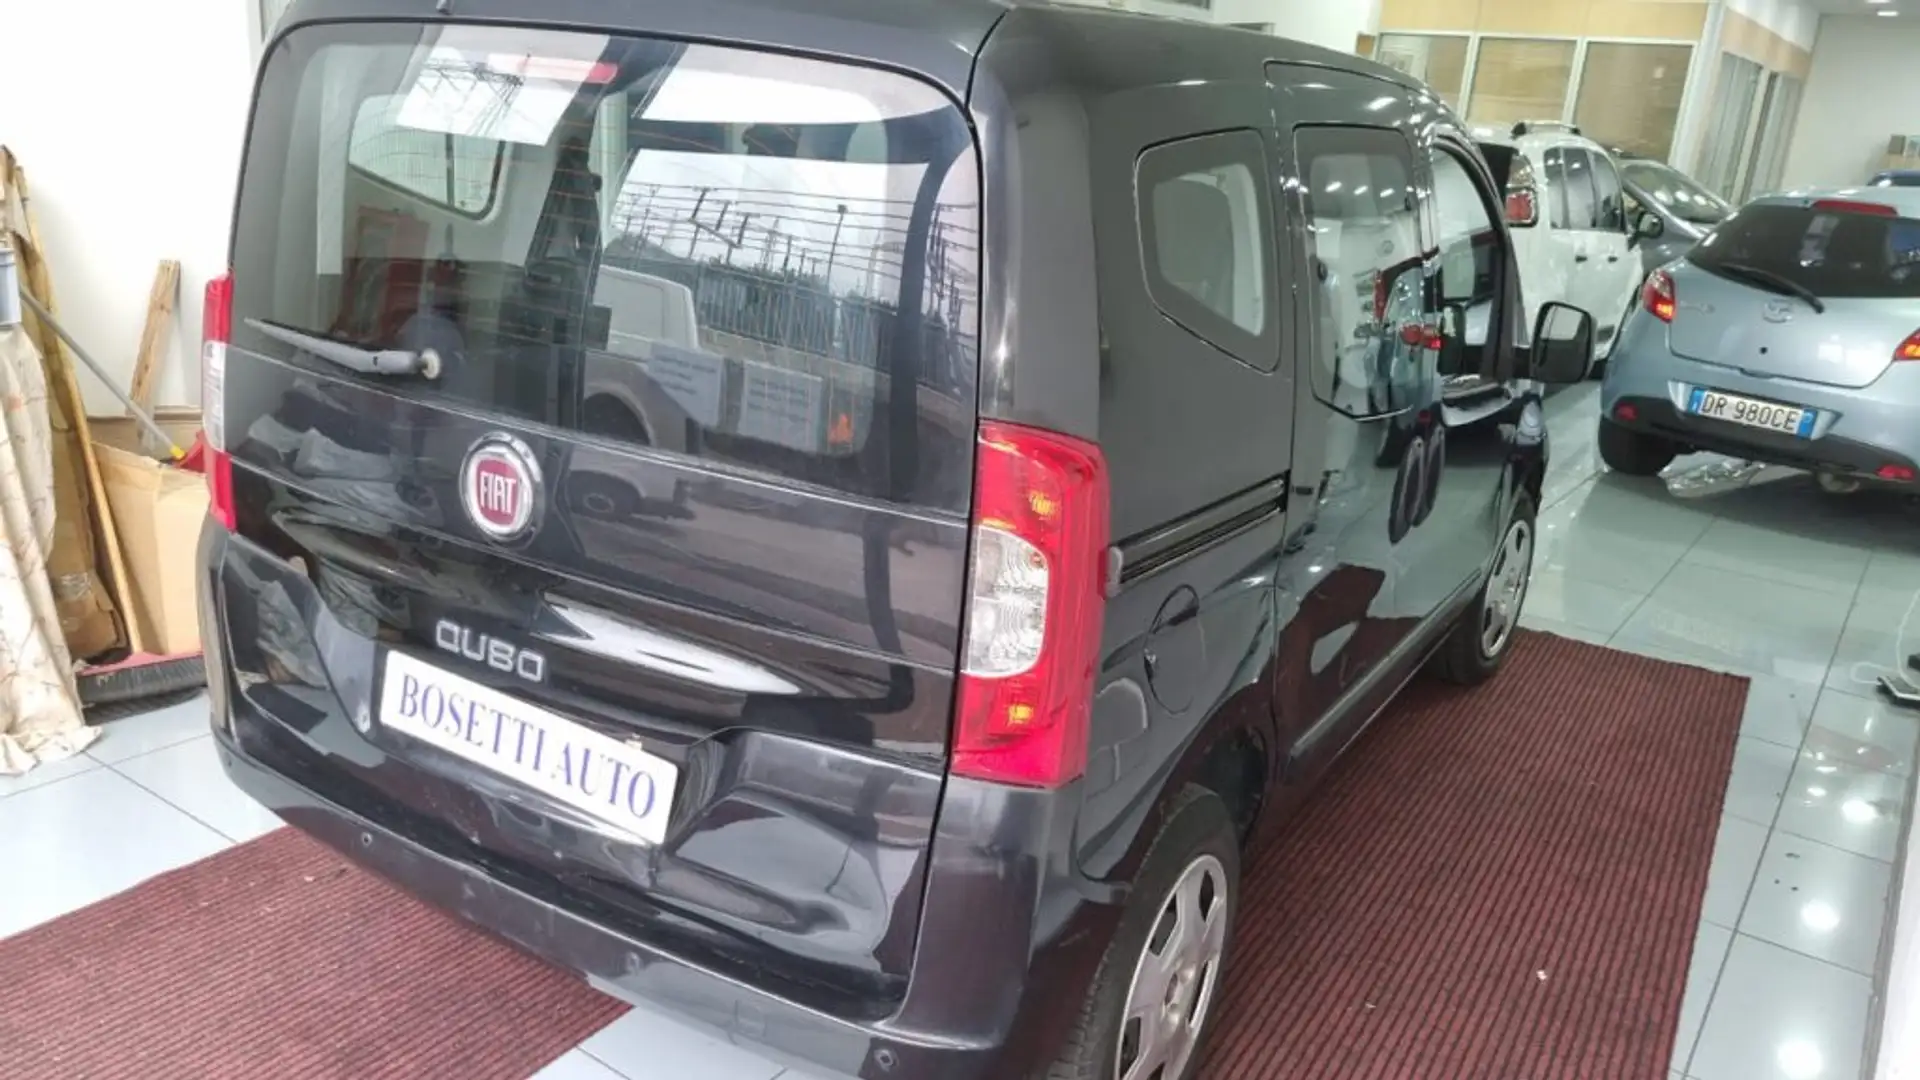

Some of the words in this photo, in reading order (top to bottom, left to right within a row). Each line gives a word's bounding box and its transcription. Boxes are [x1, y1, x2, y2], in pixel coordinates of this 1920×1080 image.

[1703, 395, 1727, 416] DR
[1733, 401, 1799, 430] 980CE
[480, 471, 516, 515] FIAT
[436, 620, 544, 682] QUBO
[400, 673, 545, 771] BOSETTI
[552, 742, 655, 818] AUTO
